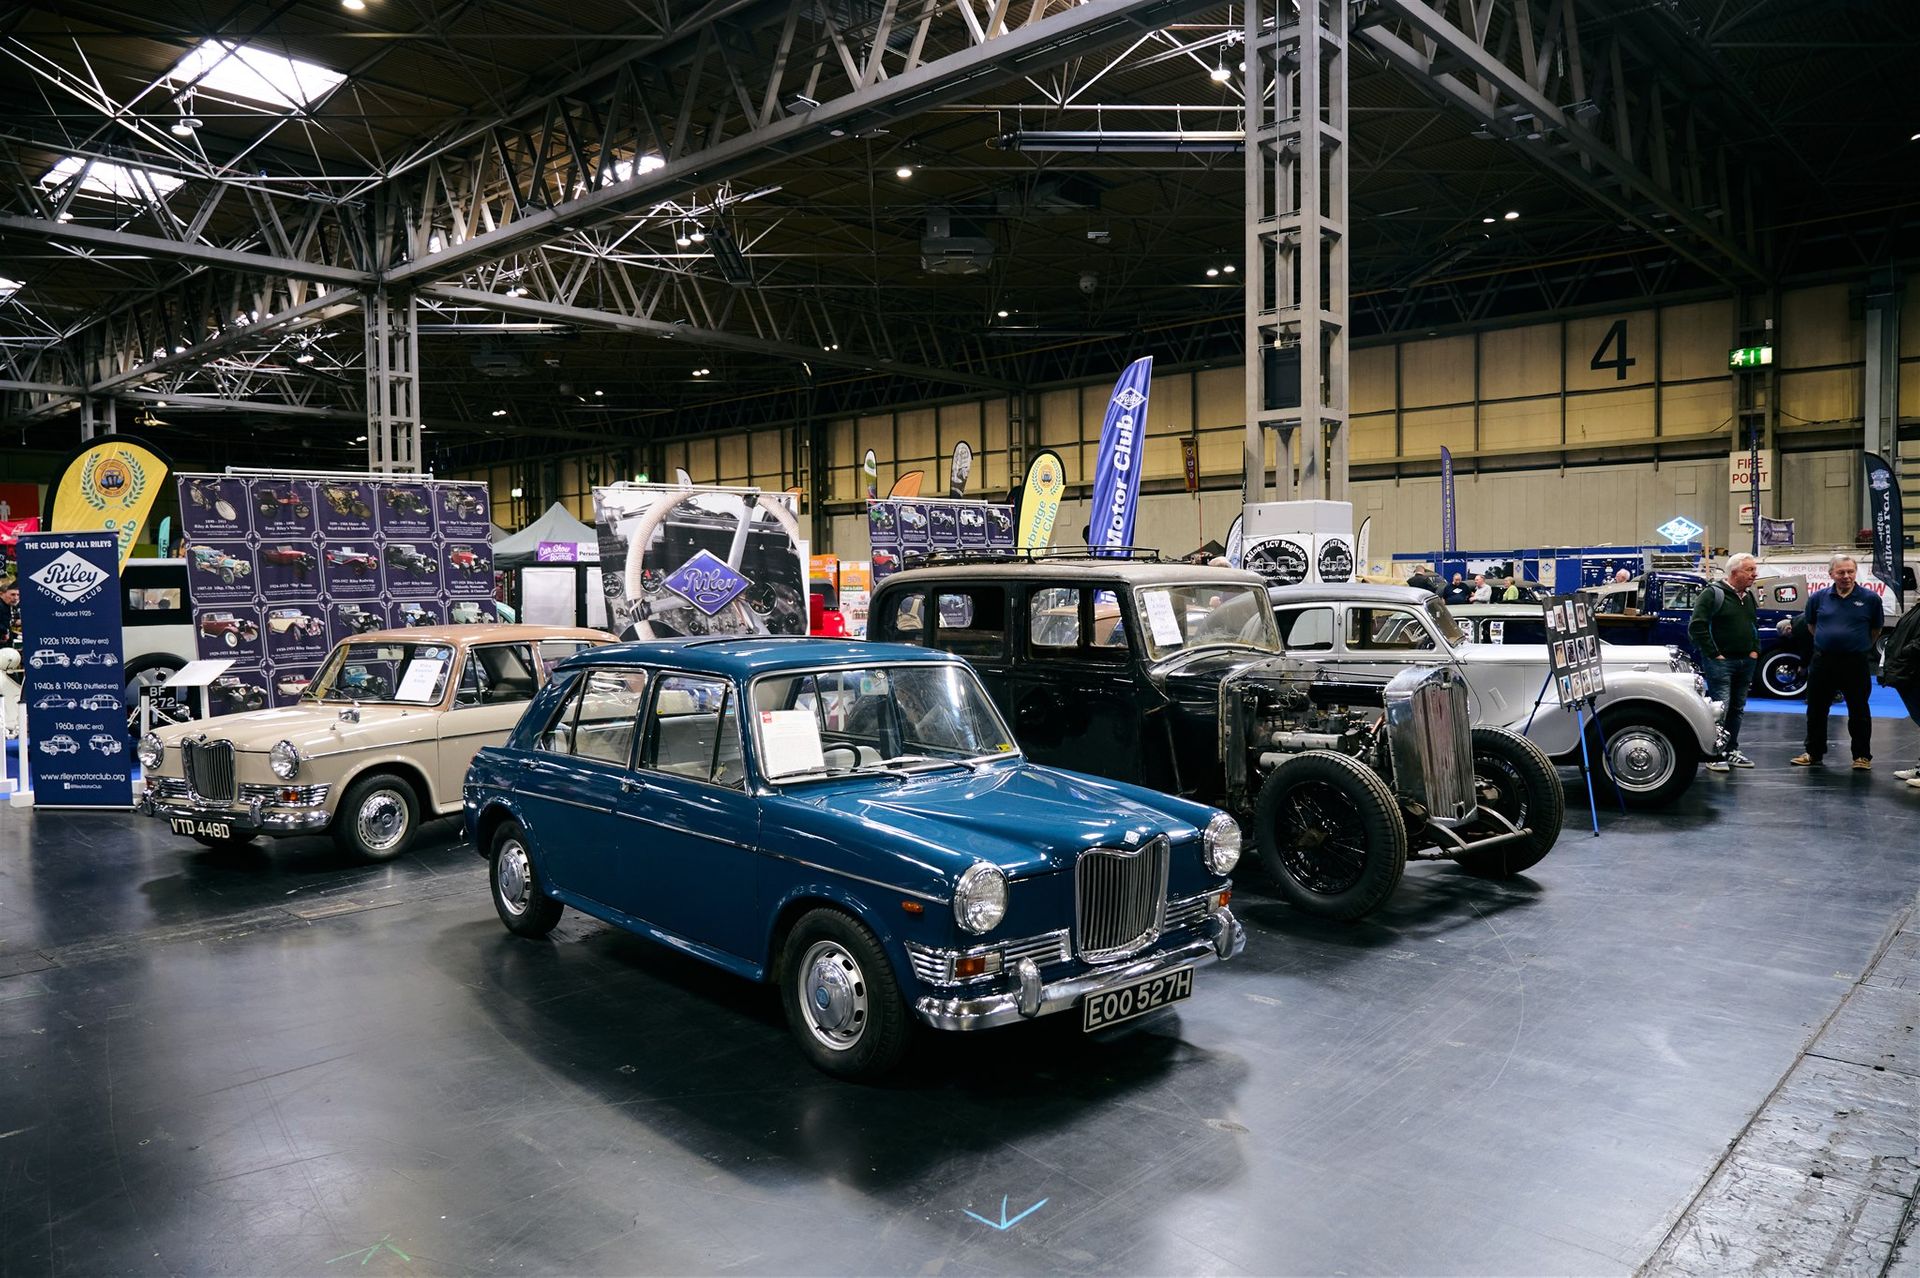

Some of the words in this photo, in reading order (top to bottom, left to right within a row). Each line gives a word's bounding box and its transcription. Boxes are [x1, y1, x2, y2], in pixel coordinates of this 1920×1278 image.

[1590, 319, 1636, 381] 4
[1114, 414, 1134, 471] Club
[1043, 502, 1058, 532] Club
[1106, 477, 1128, 553] Motor
[1245, 543, 1265, 562] Minor
[1264, 540, 1280, 549] LCV
[1280, 541, 1307, 561] Register
[43, 563, 98, 593] Riley
[681, 567, 738, 605] Riley
[37, 585, 67, 606] MOTOR
[79, 585, 103, 604] CLUB
[39, 637, 60, 645] 1920s
[61, 637, 80, 645] 1930s
[33, 682, 54, 690] 1940s
[55, 682, 62, 690] &
[63, 681, 83, 690] 1950s
[150, 687, 166, 697] BF
[150, 697, 176, 708] 272
[55, 722, 75, 730] 1960s
[40, 773, 126, 782] www.rileymotorclub.org
[170, 818, 195, 835] VTD
[197, 821, 230, 839] 448D
[1088, 989, 1133, 1027] EOO
[1137, 970, 1192, 1010] 527H
